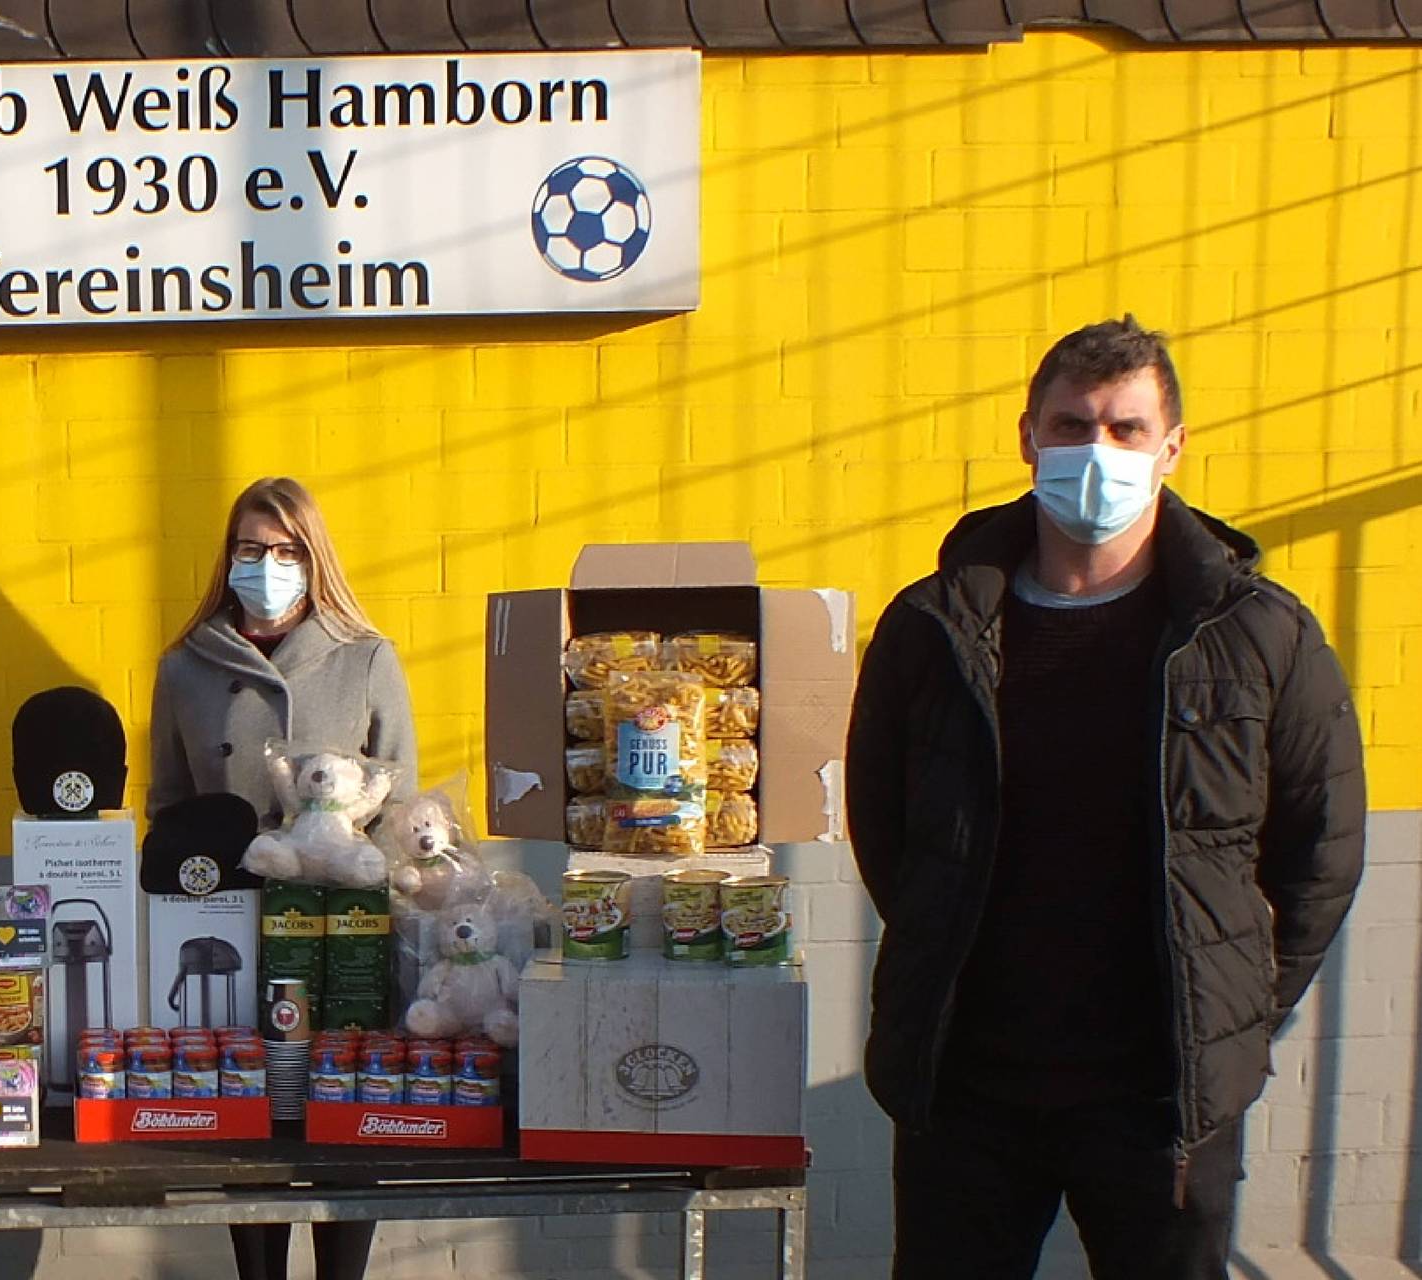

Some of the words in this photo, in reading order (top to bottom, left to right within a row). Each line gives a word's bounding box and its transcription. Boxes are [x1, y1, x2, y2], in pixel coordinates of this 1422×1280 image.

[53, 65, 239, 132] Weiß
[268, 60, 609, 129] Hamborn
[44, 154, 218, 215] 1930
[245, 150, 369, 210] e.V.
[630, 738, 667, 750] GENUSS
[629, 752, 667, 775] PUR
[272, 918, 314, 930] JACOBS
[337, 917, 379, 929] JACOBS
[135, 1111, 216, 1129] Böklunder
[363, 1115, 444, 1136] Böklunder
